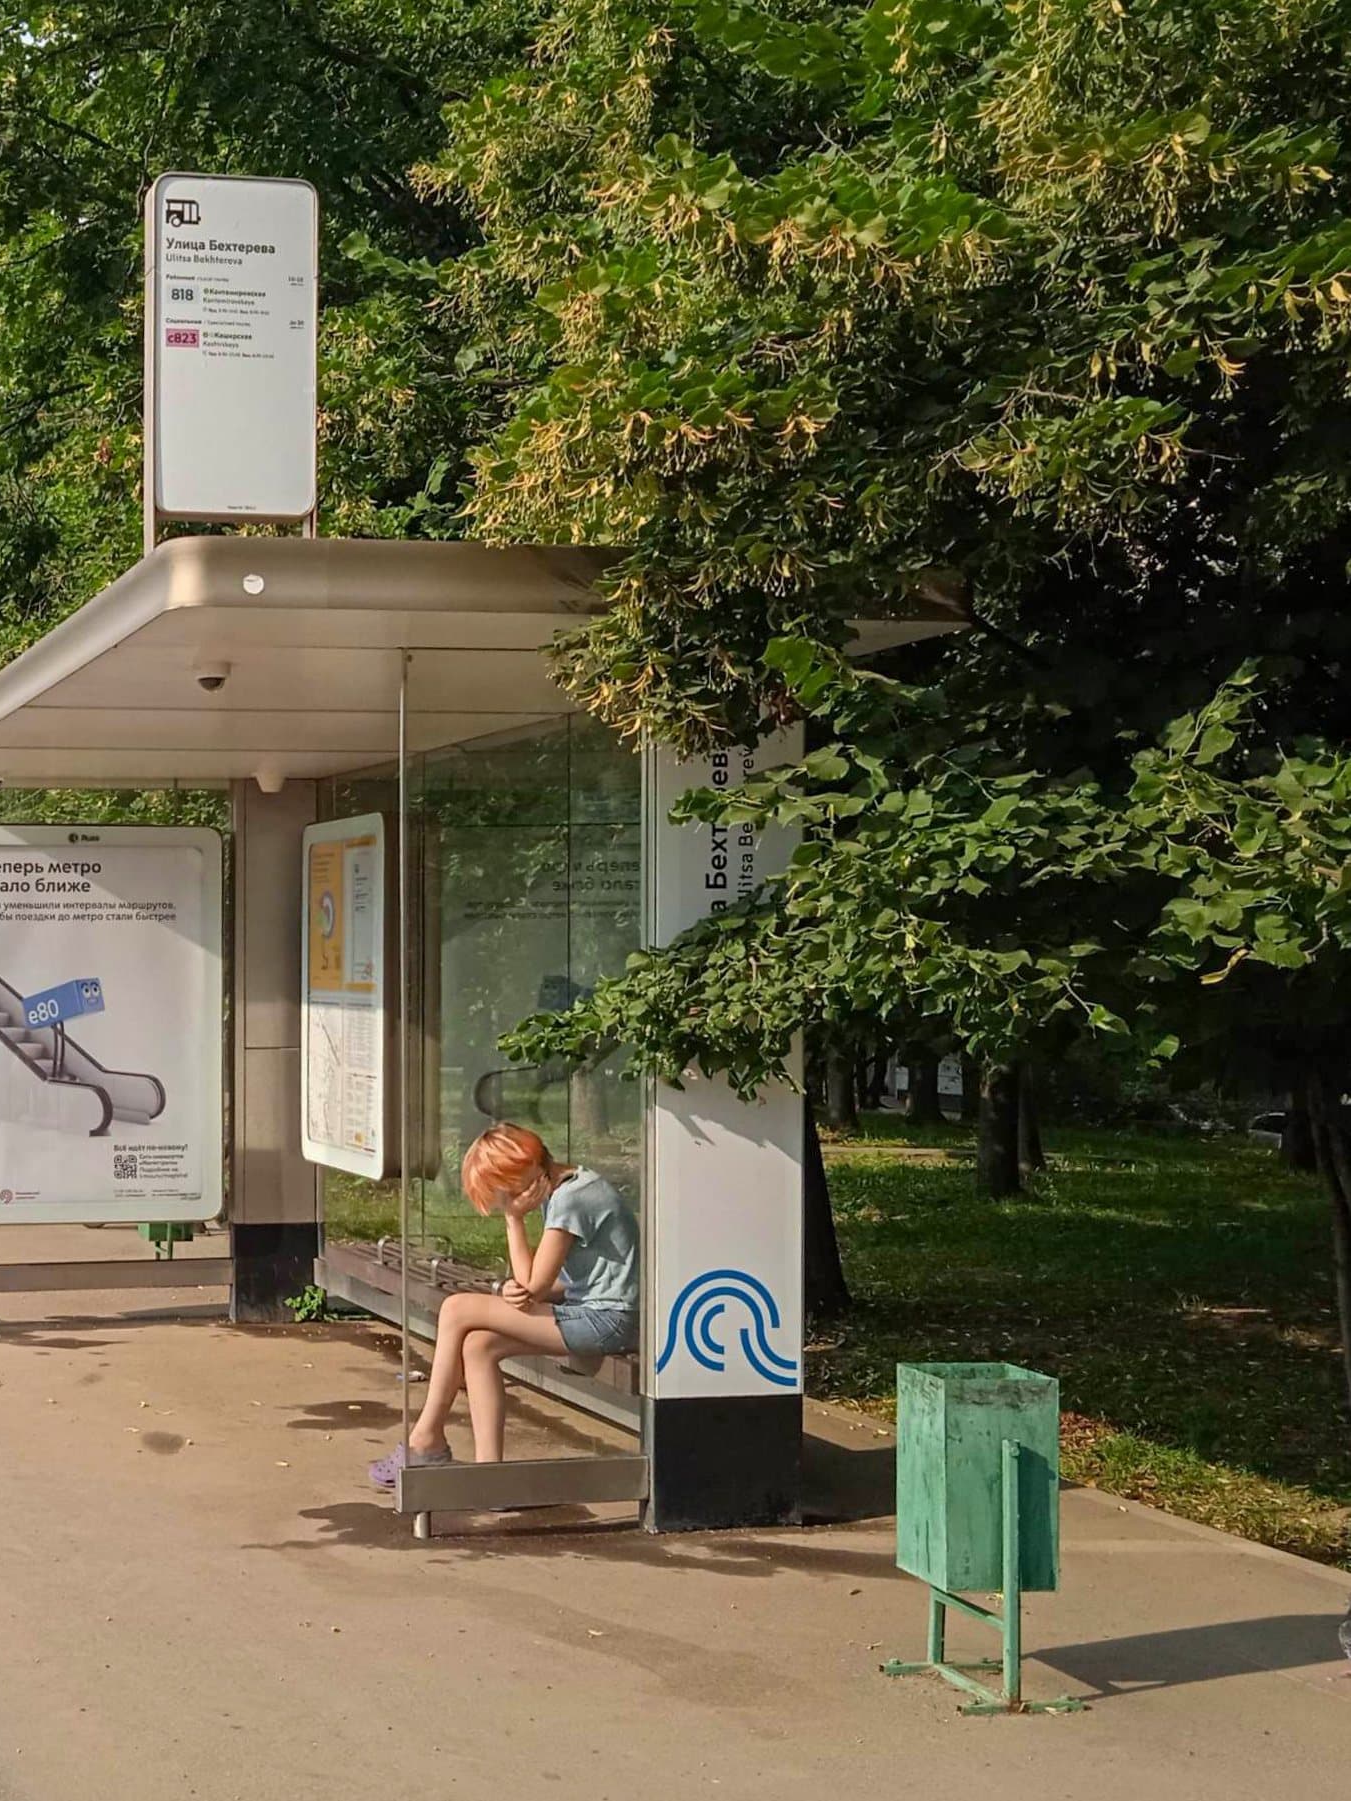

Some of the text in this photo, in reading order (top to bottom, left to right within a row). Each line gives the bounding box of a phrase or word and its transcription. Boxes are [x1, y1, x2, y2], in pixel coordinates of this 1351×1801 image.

[166, 238, 275, 254] Улица Бехтерева
[171, 288, 194, 301] 818
[705, 745, 728, 889] Бехтев
[48, 862, 102, 876] метро
[737, 853, 753, 901] litsa
[35, 878, 91, 893] ближе
[4, 902, 61, 911] уменьшили
[63, 902, 116, 911] интервалы
[15, 913, 55, 922] поездки
[57, 913, 70, 922] до
[72, 913, 103, 922] метро
[105, 913, 133, 921] стали
[135, 912, 176, 922] быстрее
